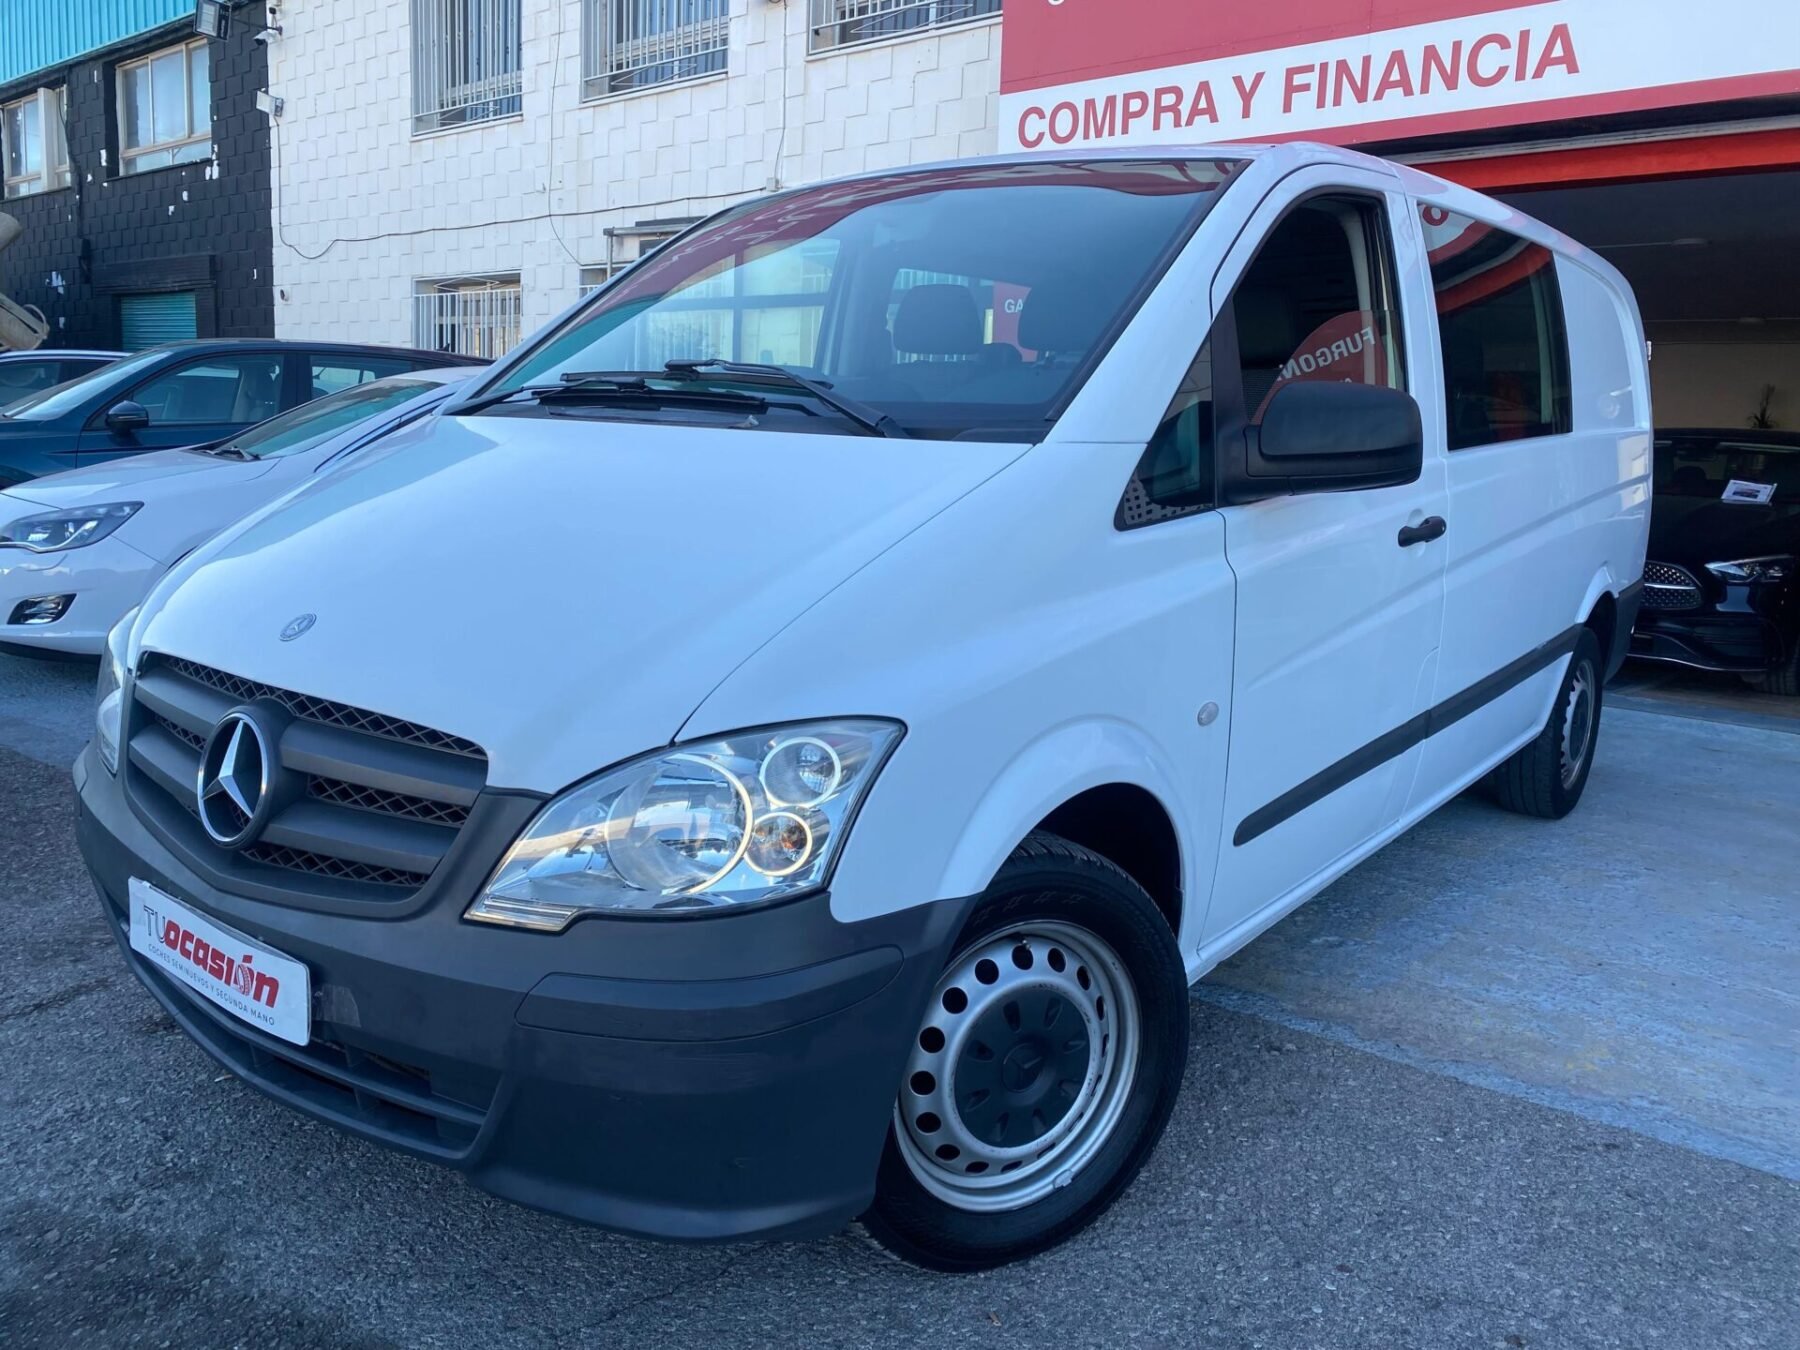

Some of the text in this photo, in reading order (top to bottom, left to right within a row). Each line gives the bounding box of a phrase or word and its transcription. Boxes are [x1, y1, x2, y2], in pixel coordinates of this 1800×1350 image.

[1018, 23, 1580, 149] COMPRA Y FINANCIA
[210, 984, 215, 993] Y
[216, 988, 248, 1012] SEGUNDA
[250, 1008, 275, 1026] MANO
